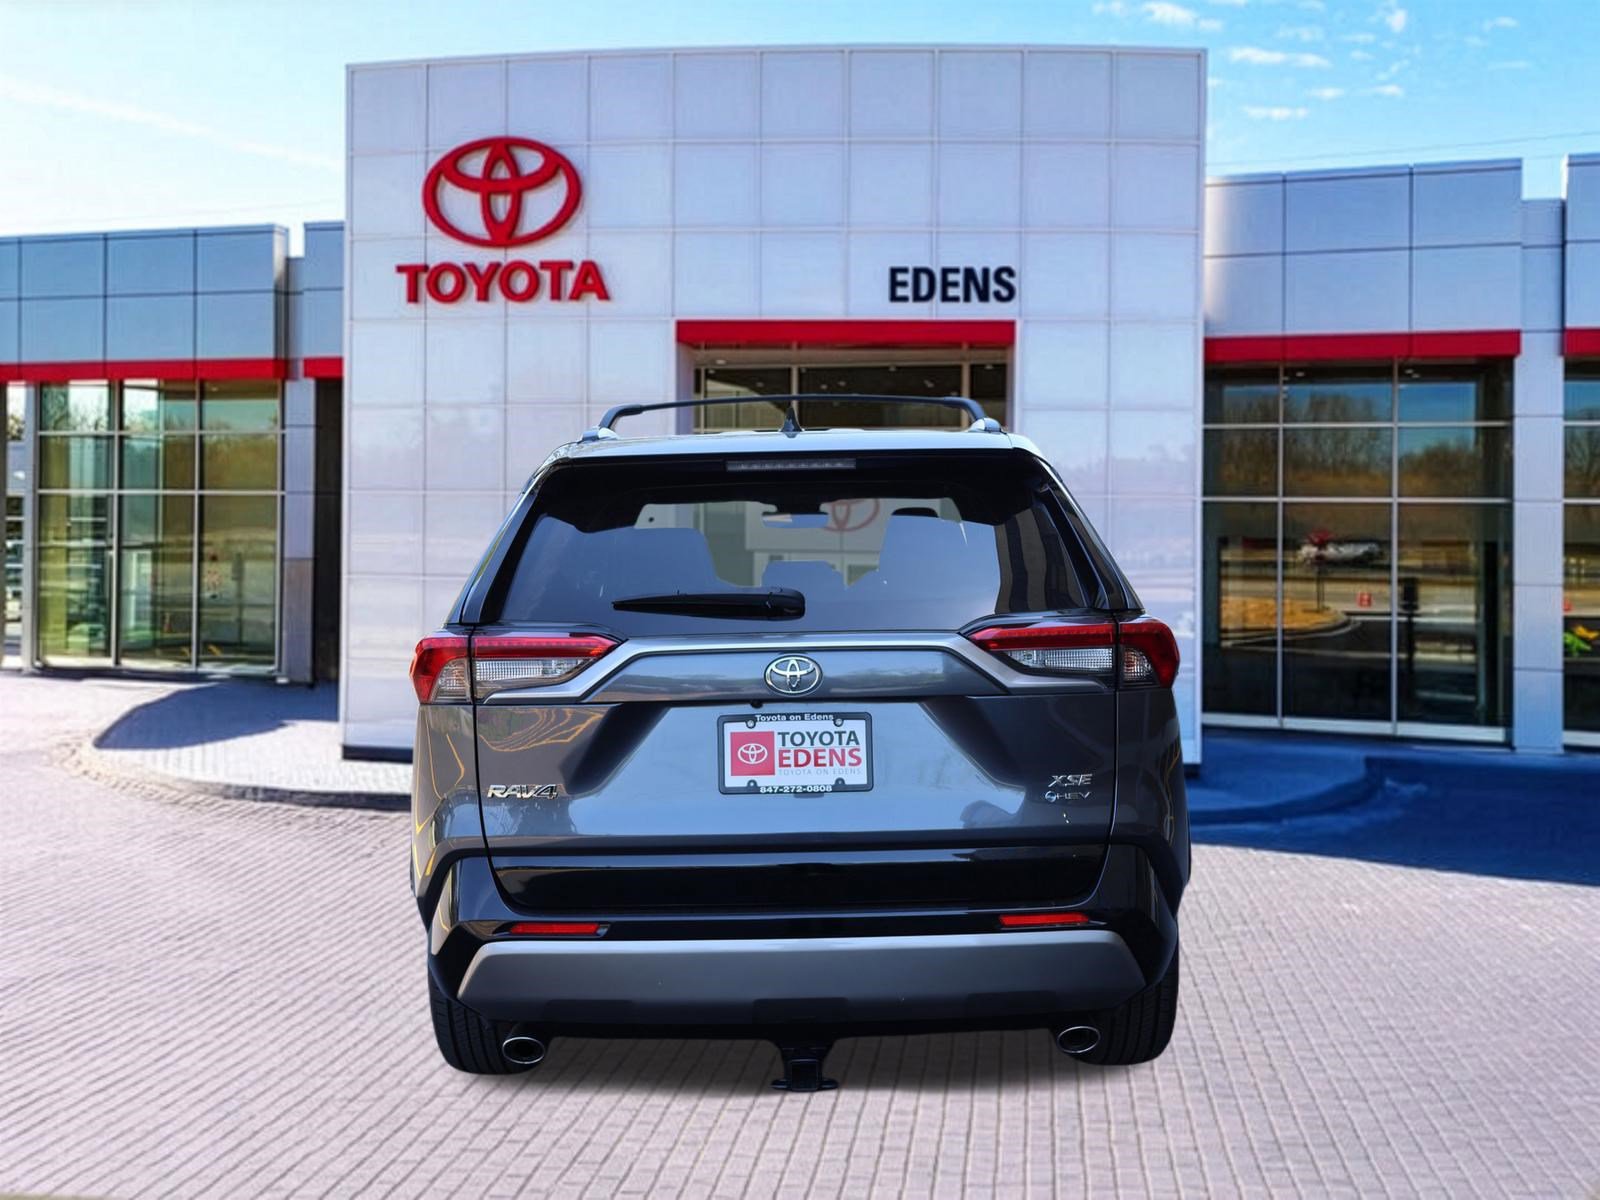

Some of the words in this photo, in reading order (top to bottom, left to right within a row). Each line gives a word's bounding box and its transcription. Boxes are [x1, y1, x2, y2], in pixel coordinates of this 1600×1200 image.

[396, 260, 610, 304] TOYOTA
[889, 266, 1016, 303] EDENS
[755, 714, 787, 722] Toyota
[804, 713, 834, 721] Edens
[777, 730, 860, 747] TOYOTA
[778, 747, 862, 768] EDENS
[779, 768, 812, 776] TOYOTA
[1048, 773, 1093, 788] XSE
[487, 784, 557, 799] RAV4
[759, 784, 833, 793] 847-272-0808
